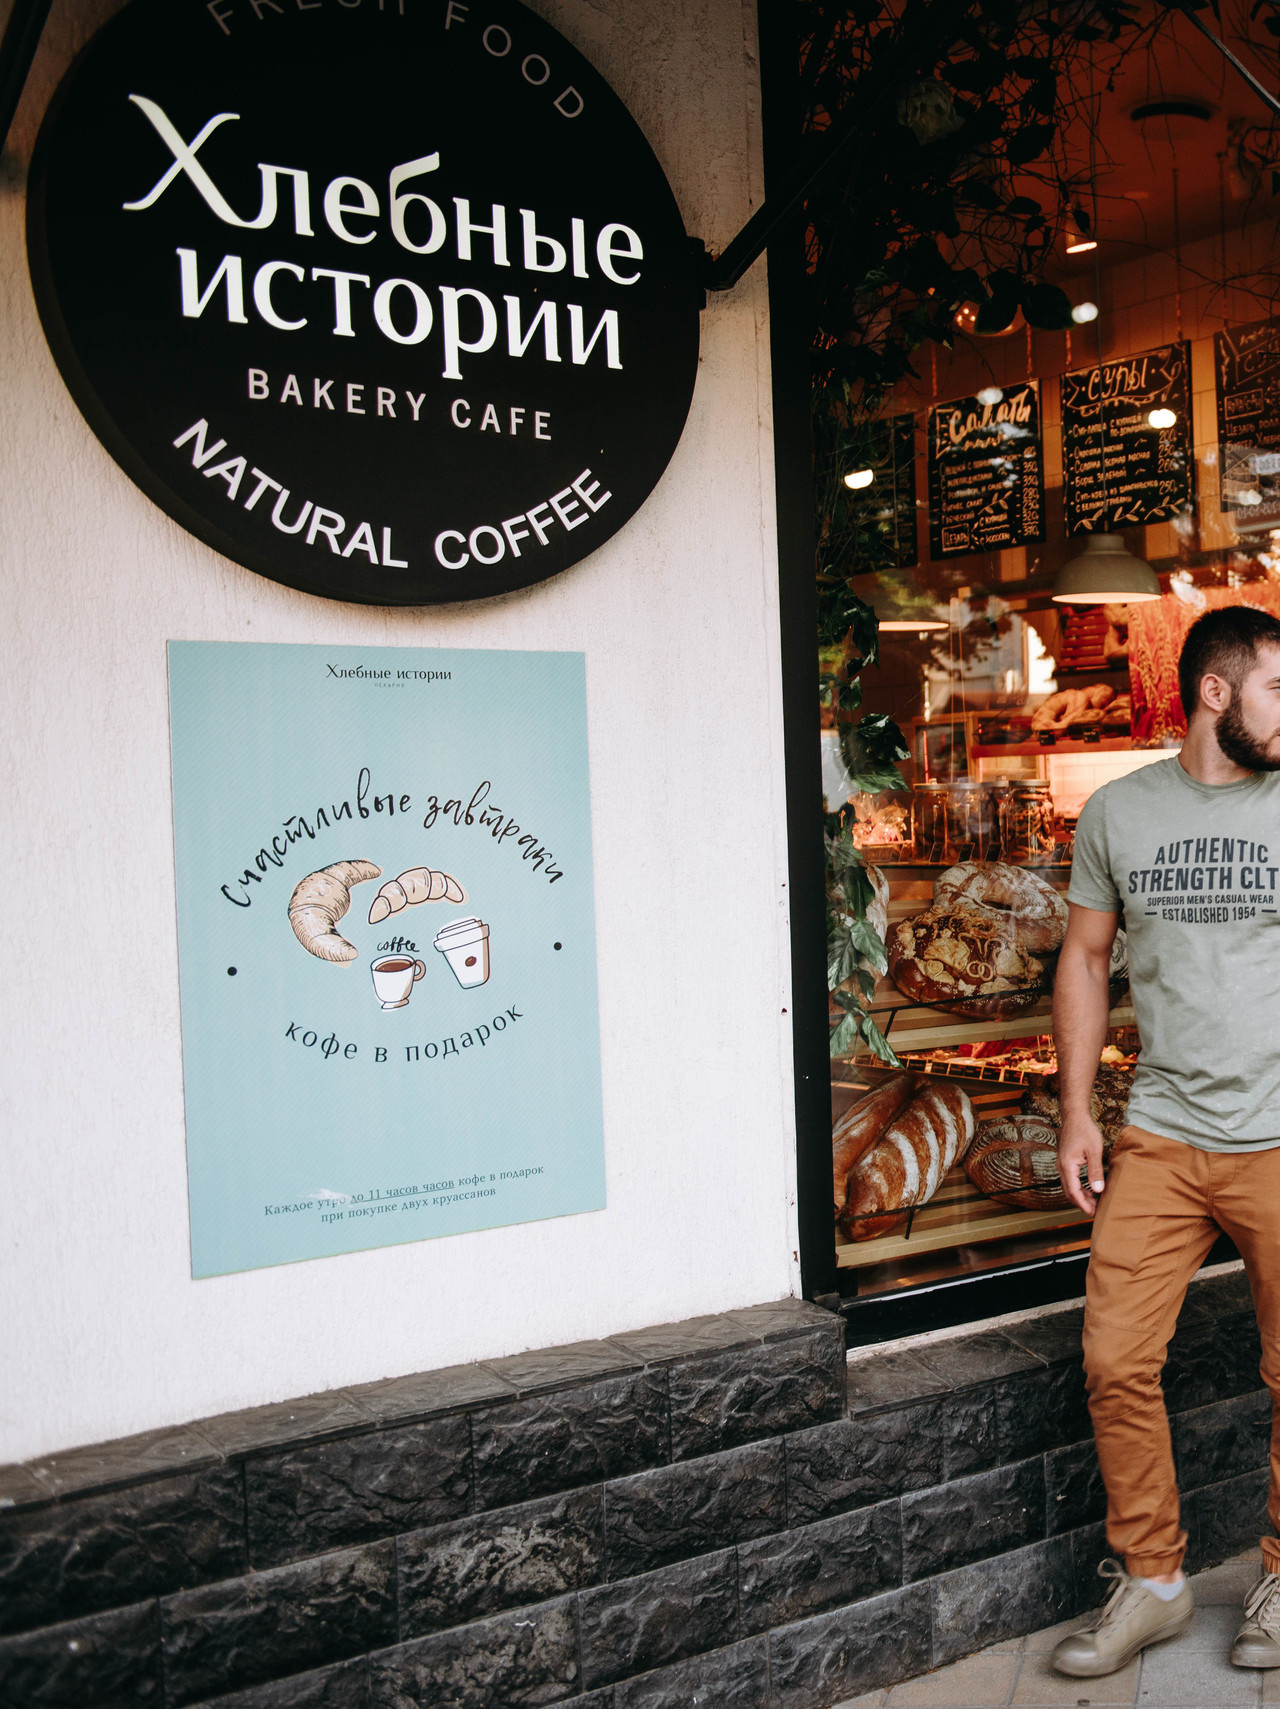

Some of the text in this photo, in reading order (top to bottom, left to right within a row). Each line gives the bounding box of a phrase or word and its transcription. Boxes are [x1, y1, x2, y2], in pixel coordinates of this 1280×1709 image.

[444, 1, 584, 119] FOOD
[122, 93, 644, 286] Хлебные
[176, 247, 624, 380] истории
[248, 368, 553, 441] BAKERY CAFE
[173, 417, 613, 570] NATURAL COFFEE
[326, 663, 452, 683] Хлебные истории
[220, 767, 564, 908] Счастливые завтраки
[1154, 837, 1269, 865] AUTHENTIC
[1128, 867, 1233, 894] STRENGTH
[1147, 894, 1274, 907] SUPERIOR MEN'S CASUAL WEAR
[1162, 906, 1256, 924] ESTABLISHED 1954
[376, 937, 421, 953] coffee
[285, 1004, 525, 1063] кофе в подарок
[264, 1201, 314, 1216] Каждое
[350, 1193, 364, 1204] до
[369, 1189, 382, 1200] 11
[386, 1185, 419, 1198] часов
[422, 1178, 455, 1191] часов
[458, 1173, 486, 1188] кофе
[489, 1172, 496, 1181] в
[499, 1165, 545, 1180] подарок
[321, 1187, 497, 1223] при покупке двух круассанов
